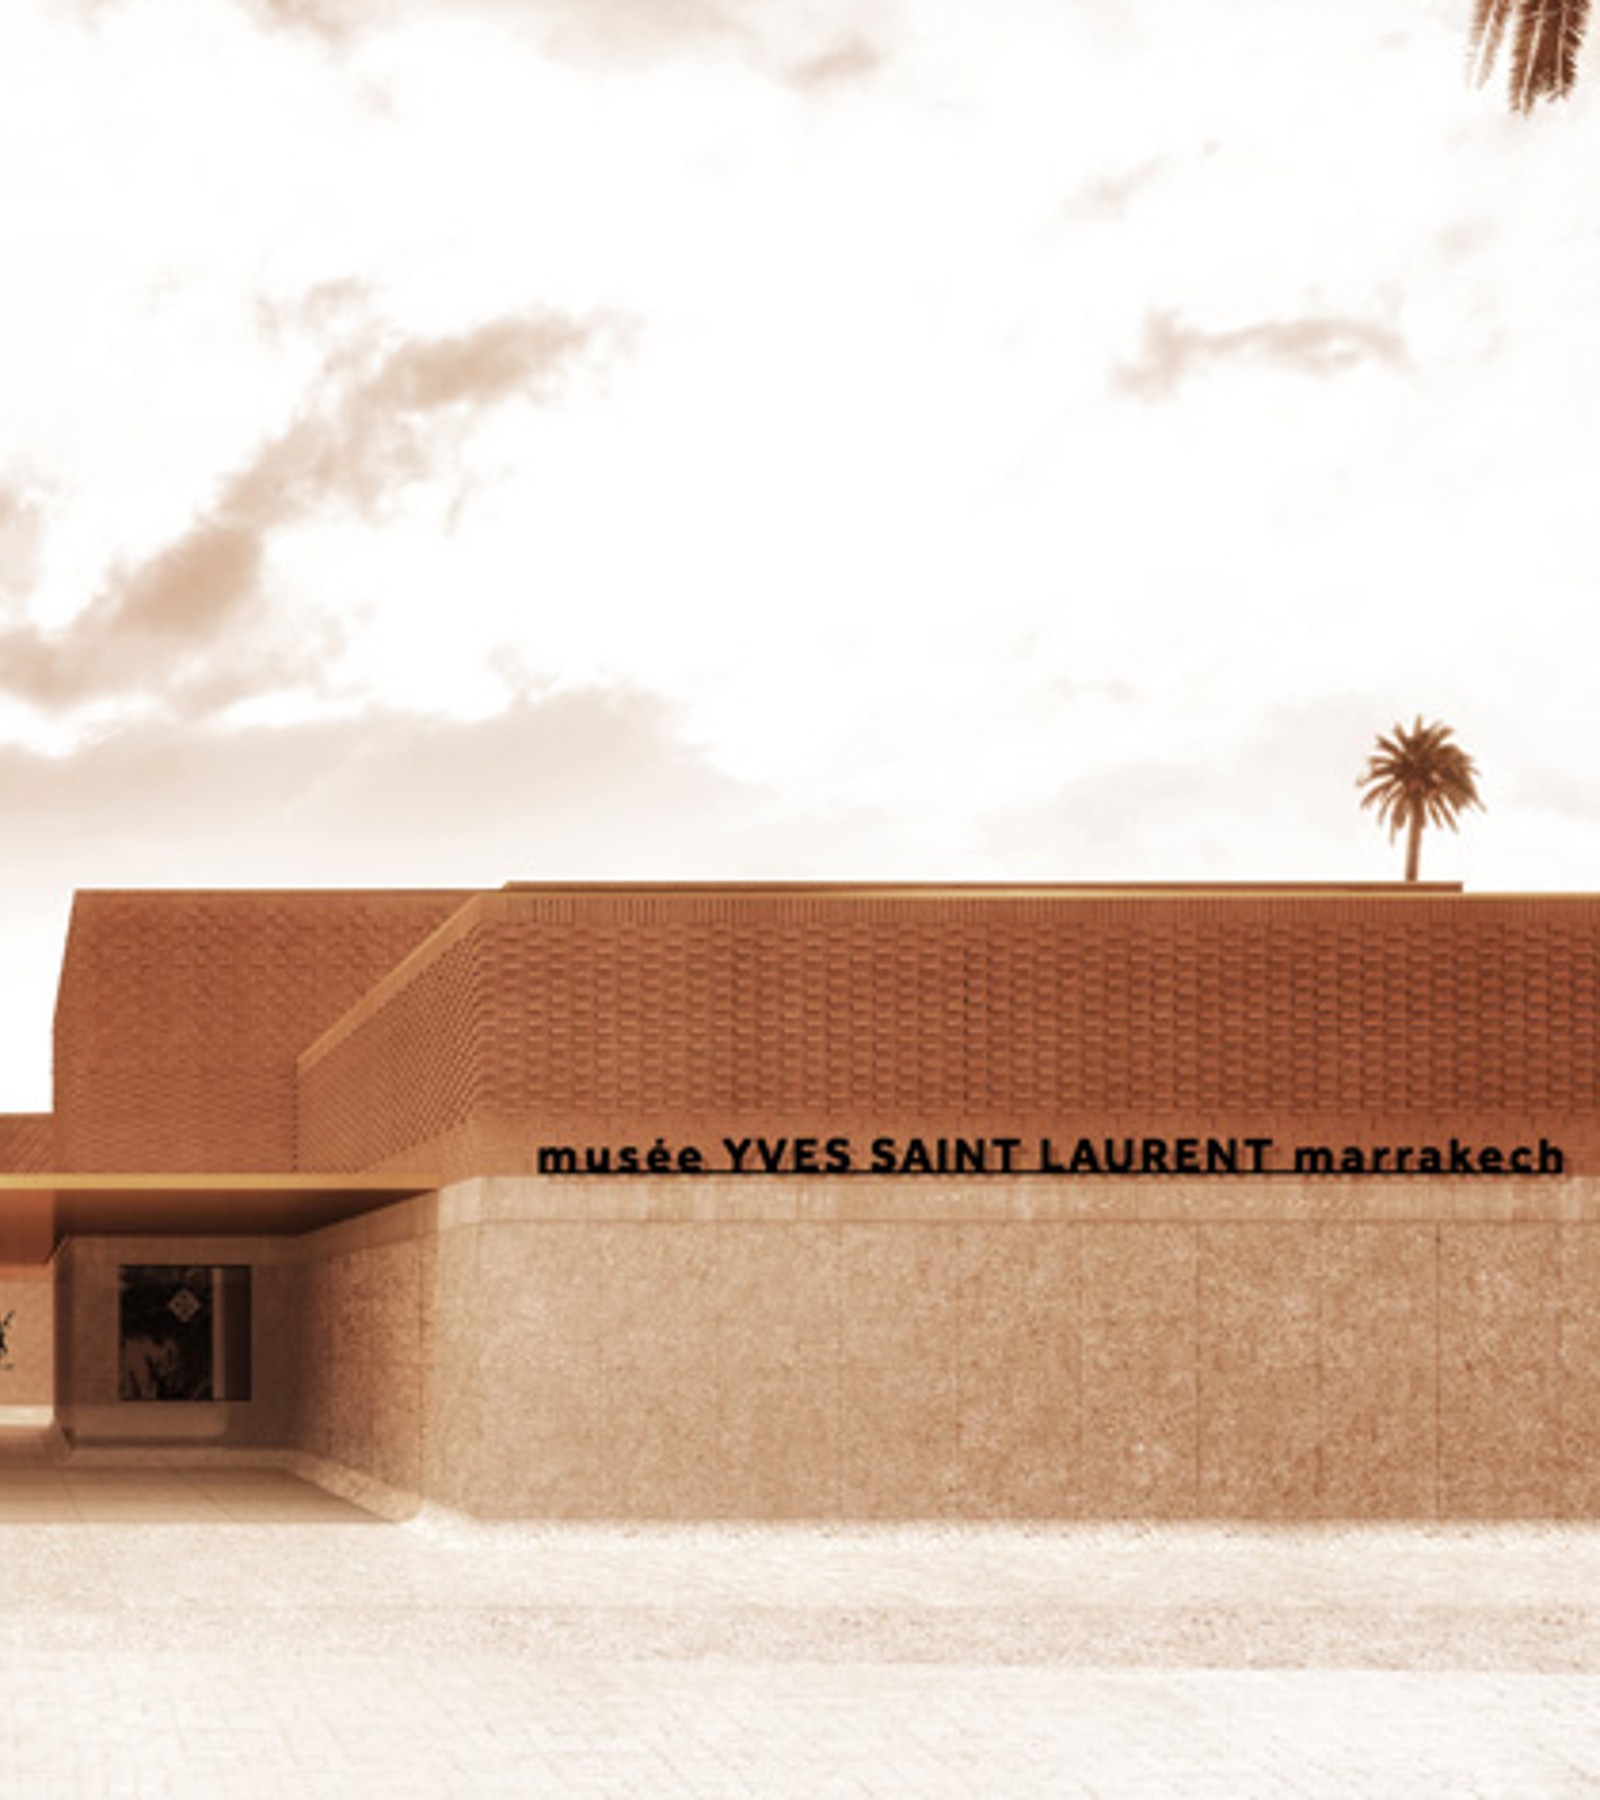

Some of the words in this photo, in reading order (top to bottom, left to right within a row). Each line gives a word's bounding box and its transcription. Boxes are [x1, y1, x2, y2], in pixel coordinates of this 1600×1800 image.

[537, 1138, 704, 1174] musée
[722, 1138, 852, 1174] YVES
[871, 1138, 1022, 1174] SAINT
[1040, 1138, 1274, 1174] LAURENT
[1294, 1138, 1565, 1174] marrakech
